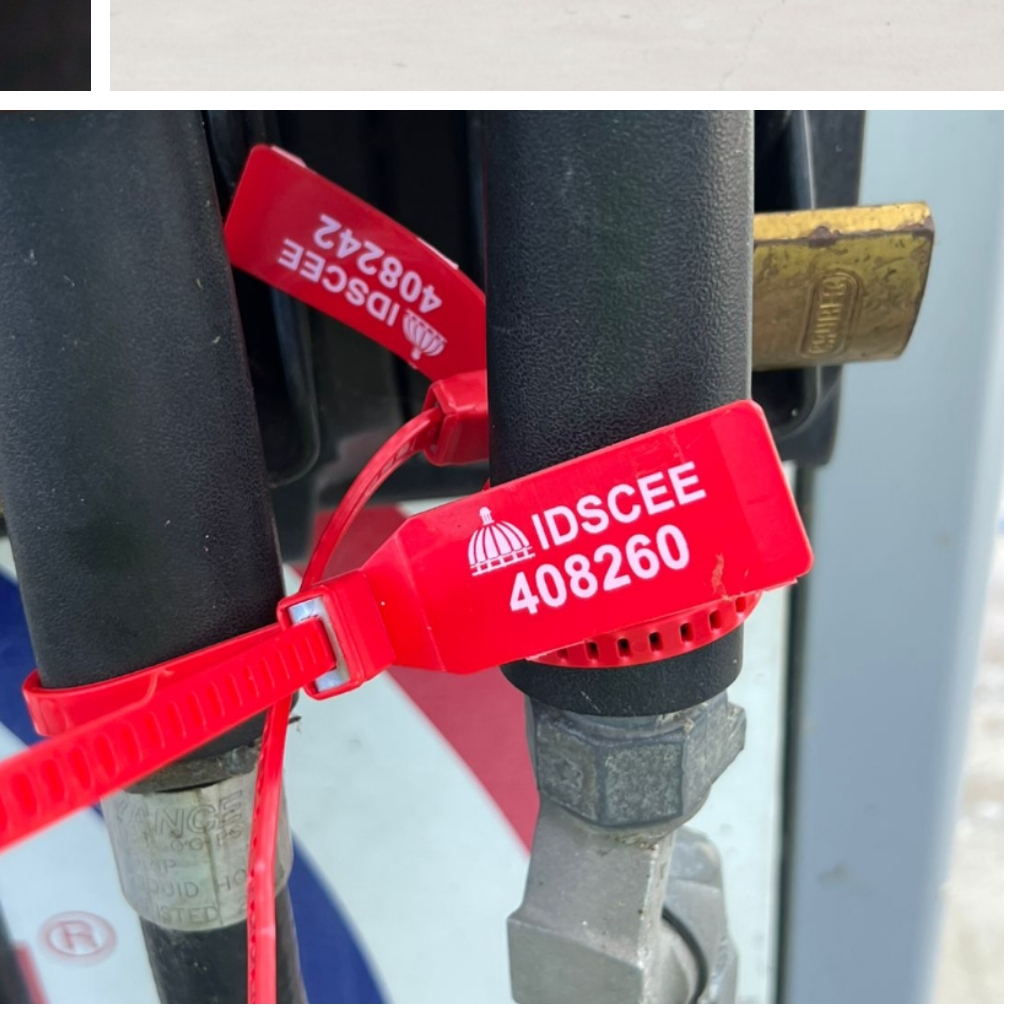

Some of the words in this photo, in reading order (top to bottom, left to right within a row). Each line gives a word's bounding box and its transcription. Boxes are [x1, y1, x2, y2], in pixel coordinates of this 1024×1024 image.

[278, 238, 400, 327] IDSCEE
[313, 214, 443, 314] 408242
[531, 461, 707, 551] IDSCEE
[509, 524, 690, 615] 408260
